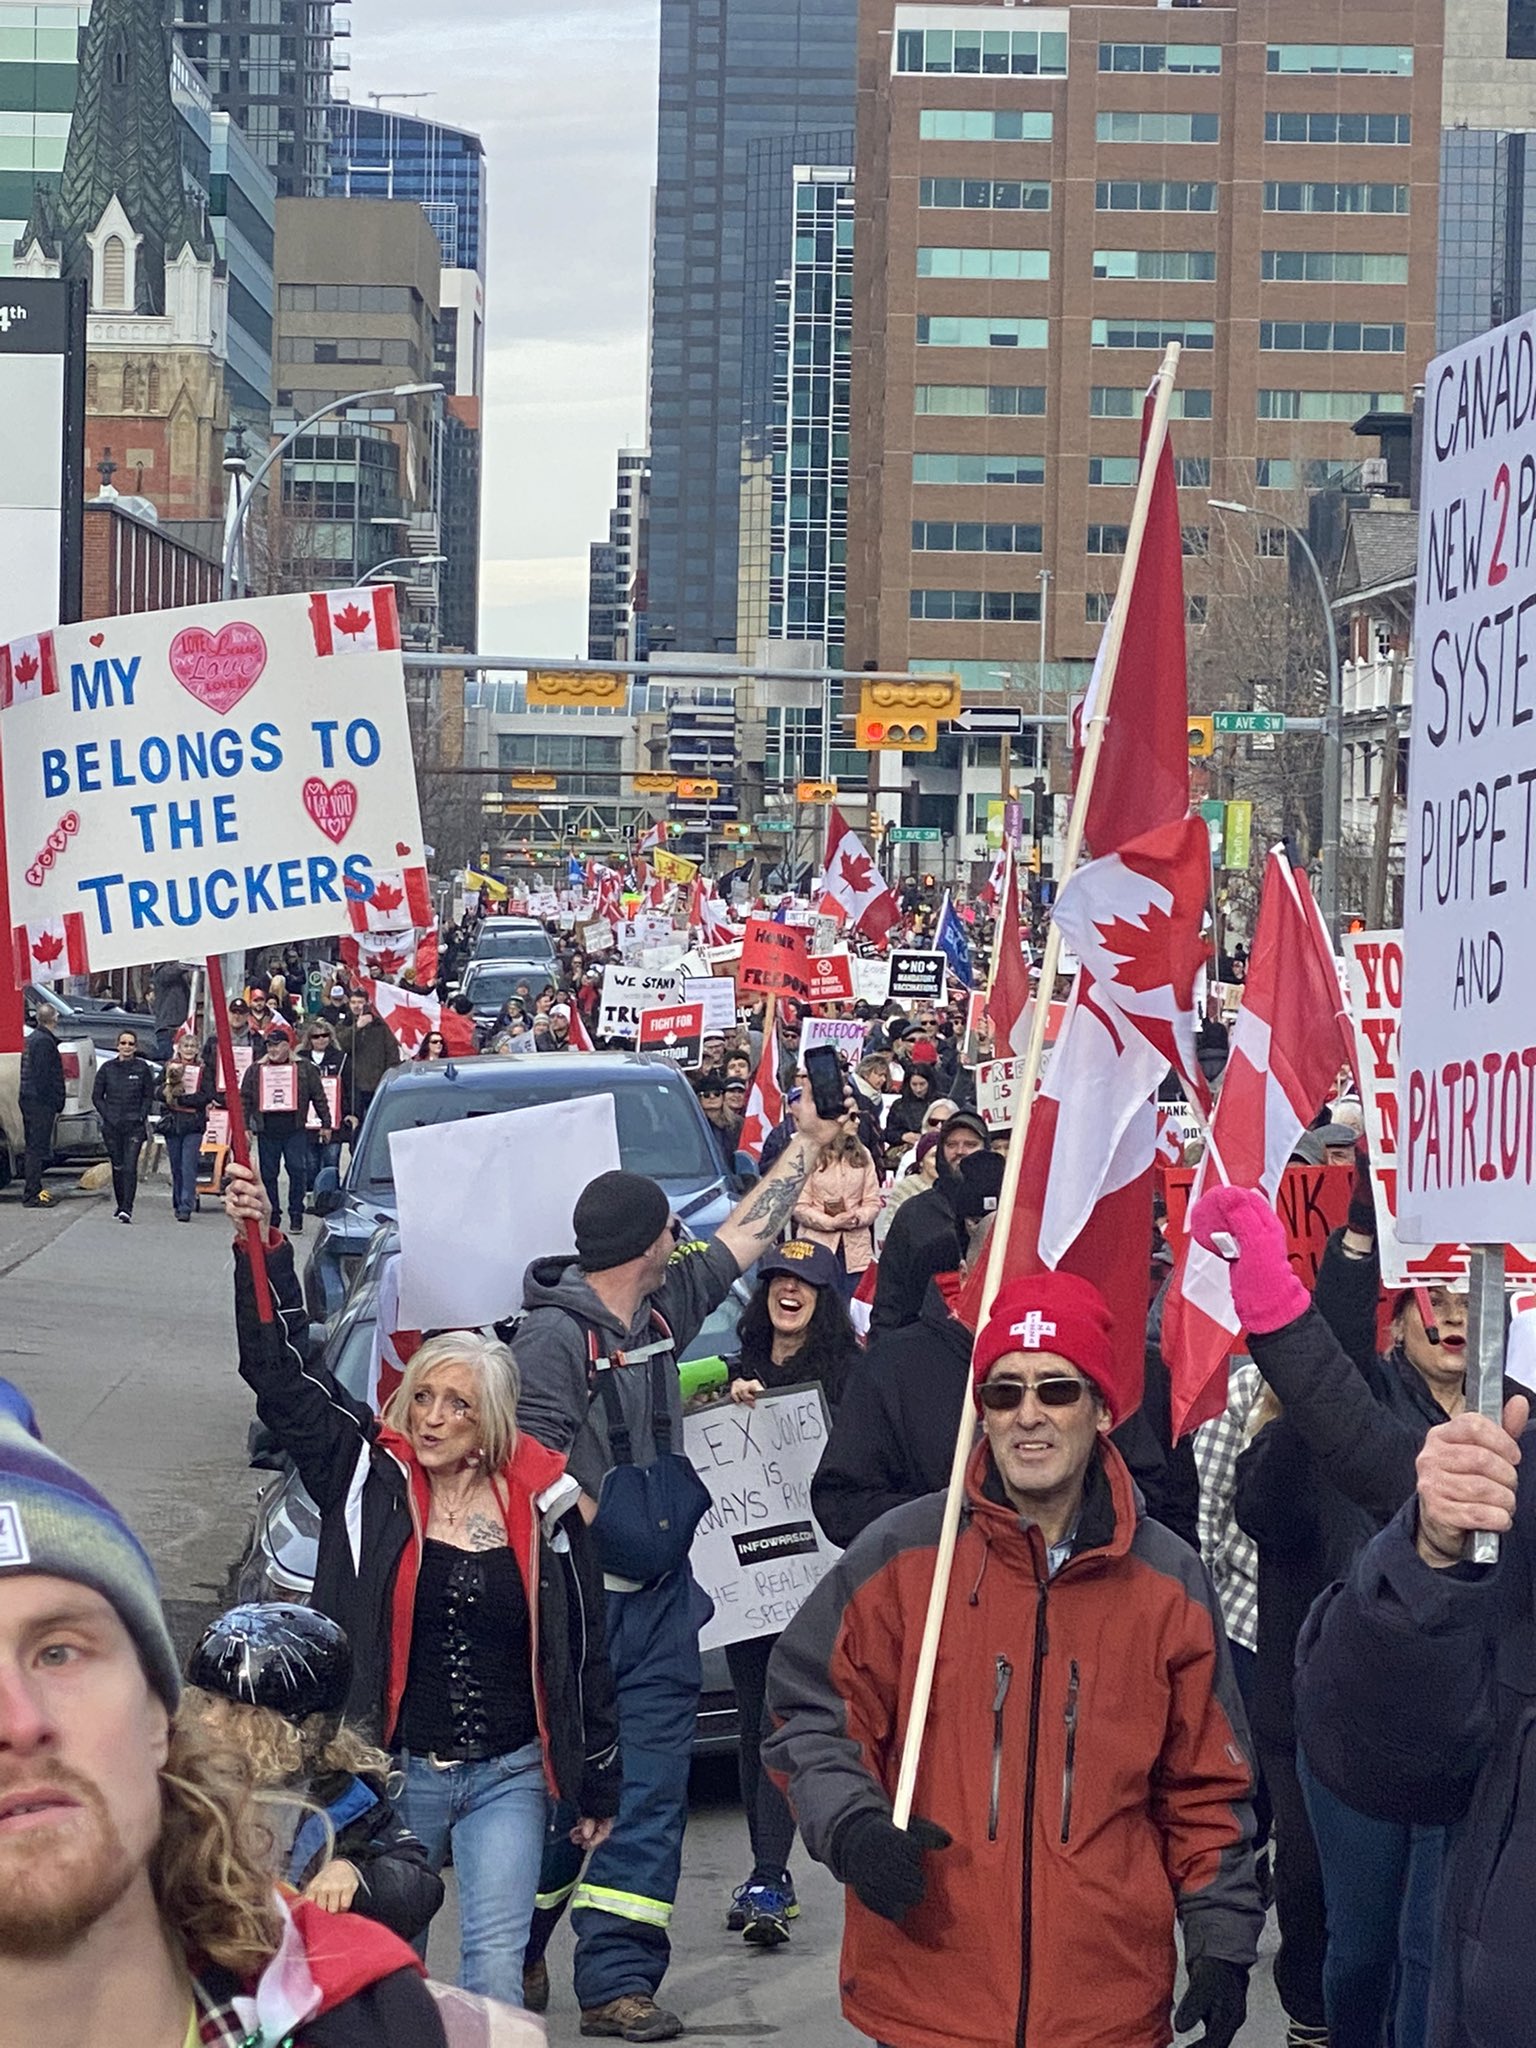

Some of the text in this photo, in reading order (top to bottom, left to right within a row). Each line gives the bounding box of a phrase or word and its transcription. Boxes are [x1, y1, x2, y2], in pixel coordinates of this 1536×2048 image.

[1433, 331, 1536, 463] CANAD
[1427, 488, 1487, 605] NEW
[1487, 462, 1511, 586] 2
[70, 655, 142, 712] MY
[1215, 716, 1281, 730] 14 AVE SW
[41, 717, 382, 799] BELONGS TO
[130, 794, 240, 854] THE
[1420, 768, 1536, 912] PUPPET
[78, 853, 376, 935] TRUCKERS
[614, 975, 636, 987] WE
[910, 960, 925, 973] NO
[1354, 942, 1404, 1009] YO
[1453, 931, 1502, 1010] AND
[605, 1006, 639, 1024] TRU
[651, 1014, 692, 1031] FIGHT FOR
[812, 1023, 867, 1039] FREEDOM
[652, 1046, 688, 1060] EEDOM
[982, 1106, 1011, 1124] ALL
[994, 1084, 1011, 1101] IS
[1158, 1105, 1188, 1116] HANK
[1408, 1047, 1536, 1192] PATRIOT
[1170, 1172, 1330, 1238] TNK
[696, 1402, 822, 1473] EX JONES
[694, 1488, 769, 1537] LWAYS
[708, 1581, 739, 1607] HE
[755, 1568, 804, 1598] REAL
[745, 1598, 802, 1629] SPEA
